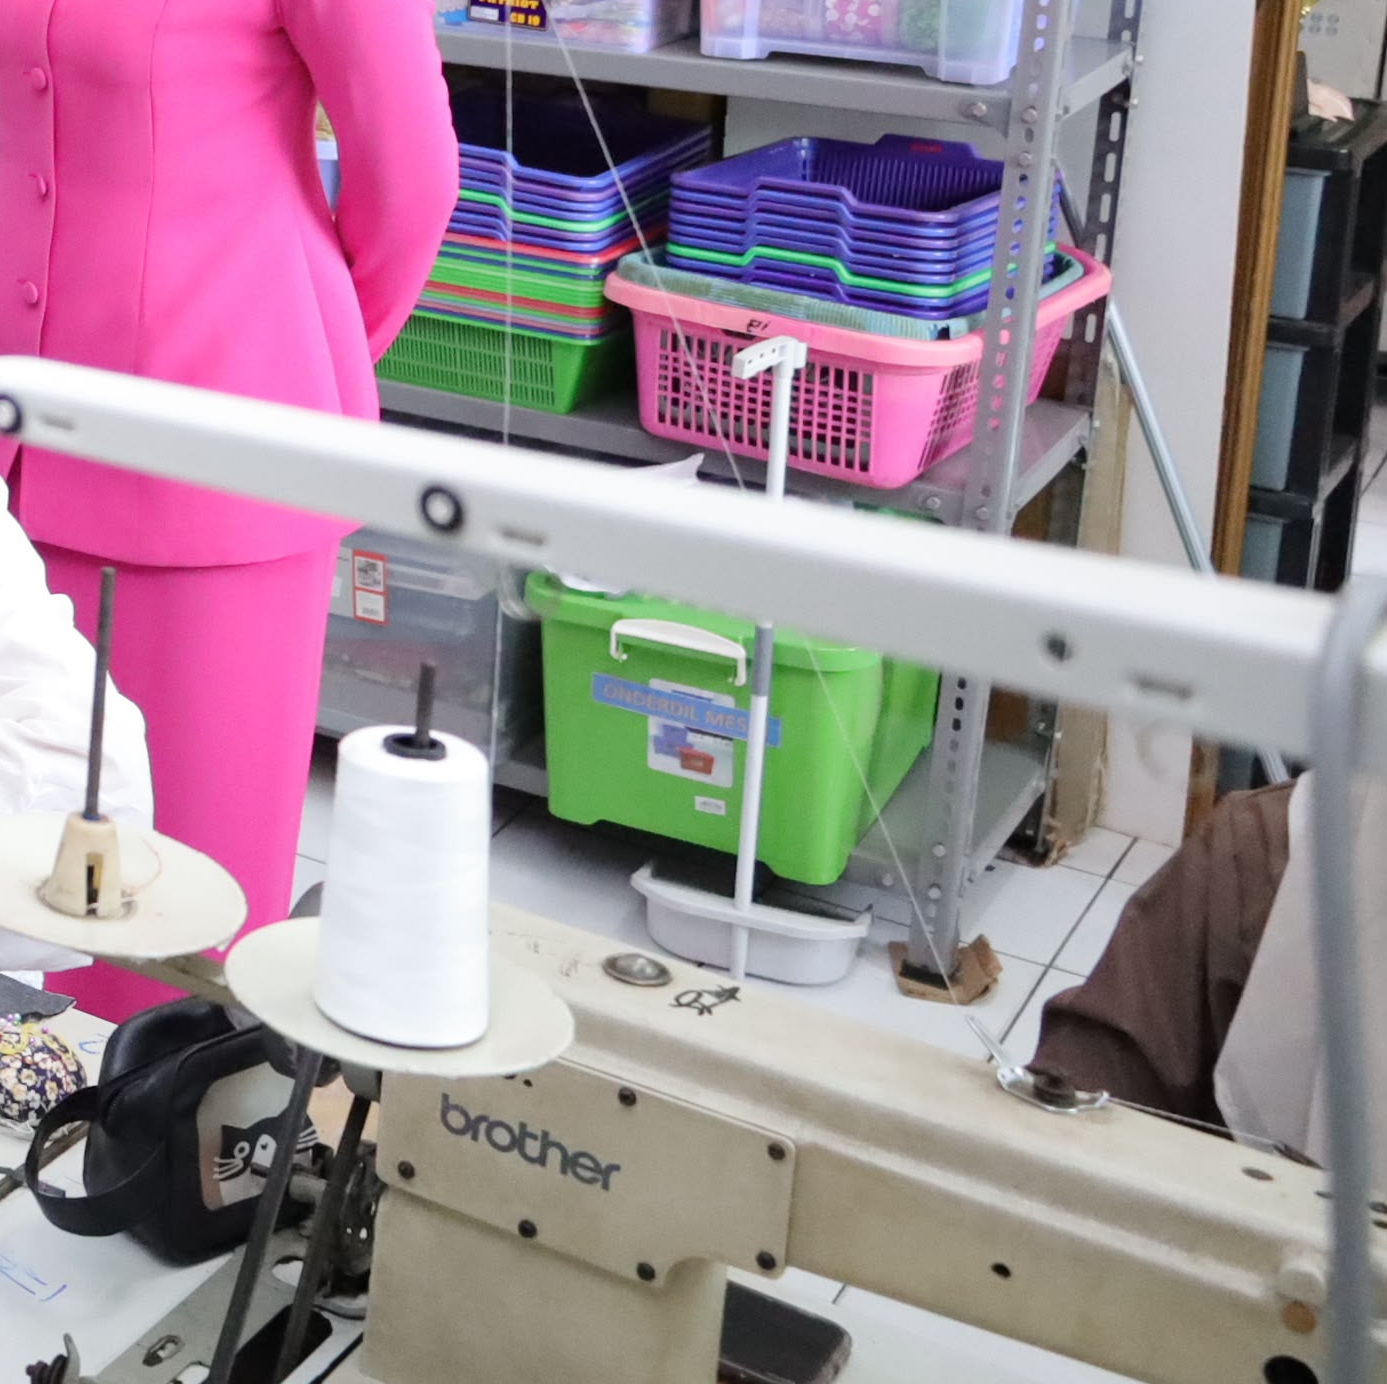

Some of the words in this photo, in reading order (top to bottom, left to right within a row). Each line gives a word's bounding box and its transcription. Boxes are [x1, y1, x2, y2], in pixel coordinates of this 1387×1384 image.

[510, 12, 525, 24] CB
[603, 684, 697, 721] ONDERDIL
[705, 710, 748, 732] MES
[440, 1092, 621, 1192] brother
